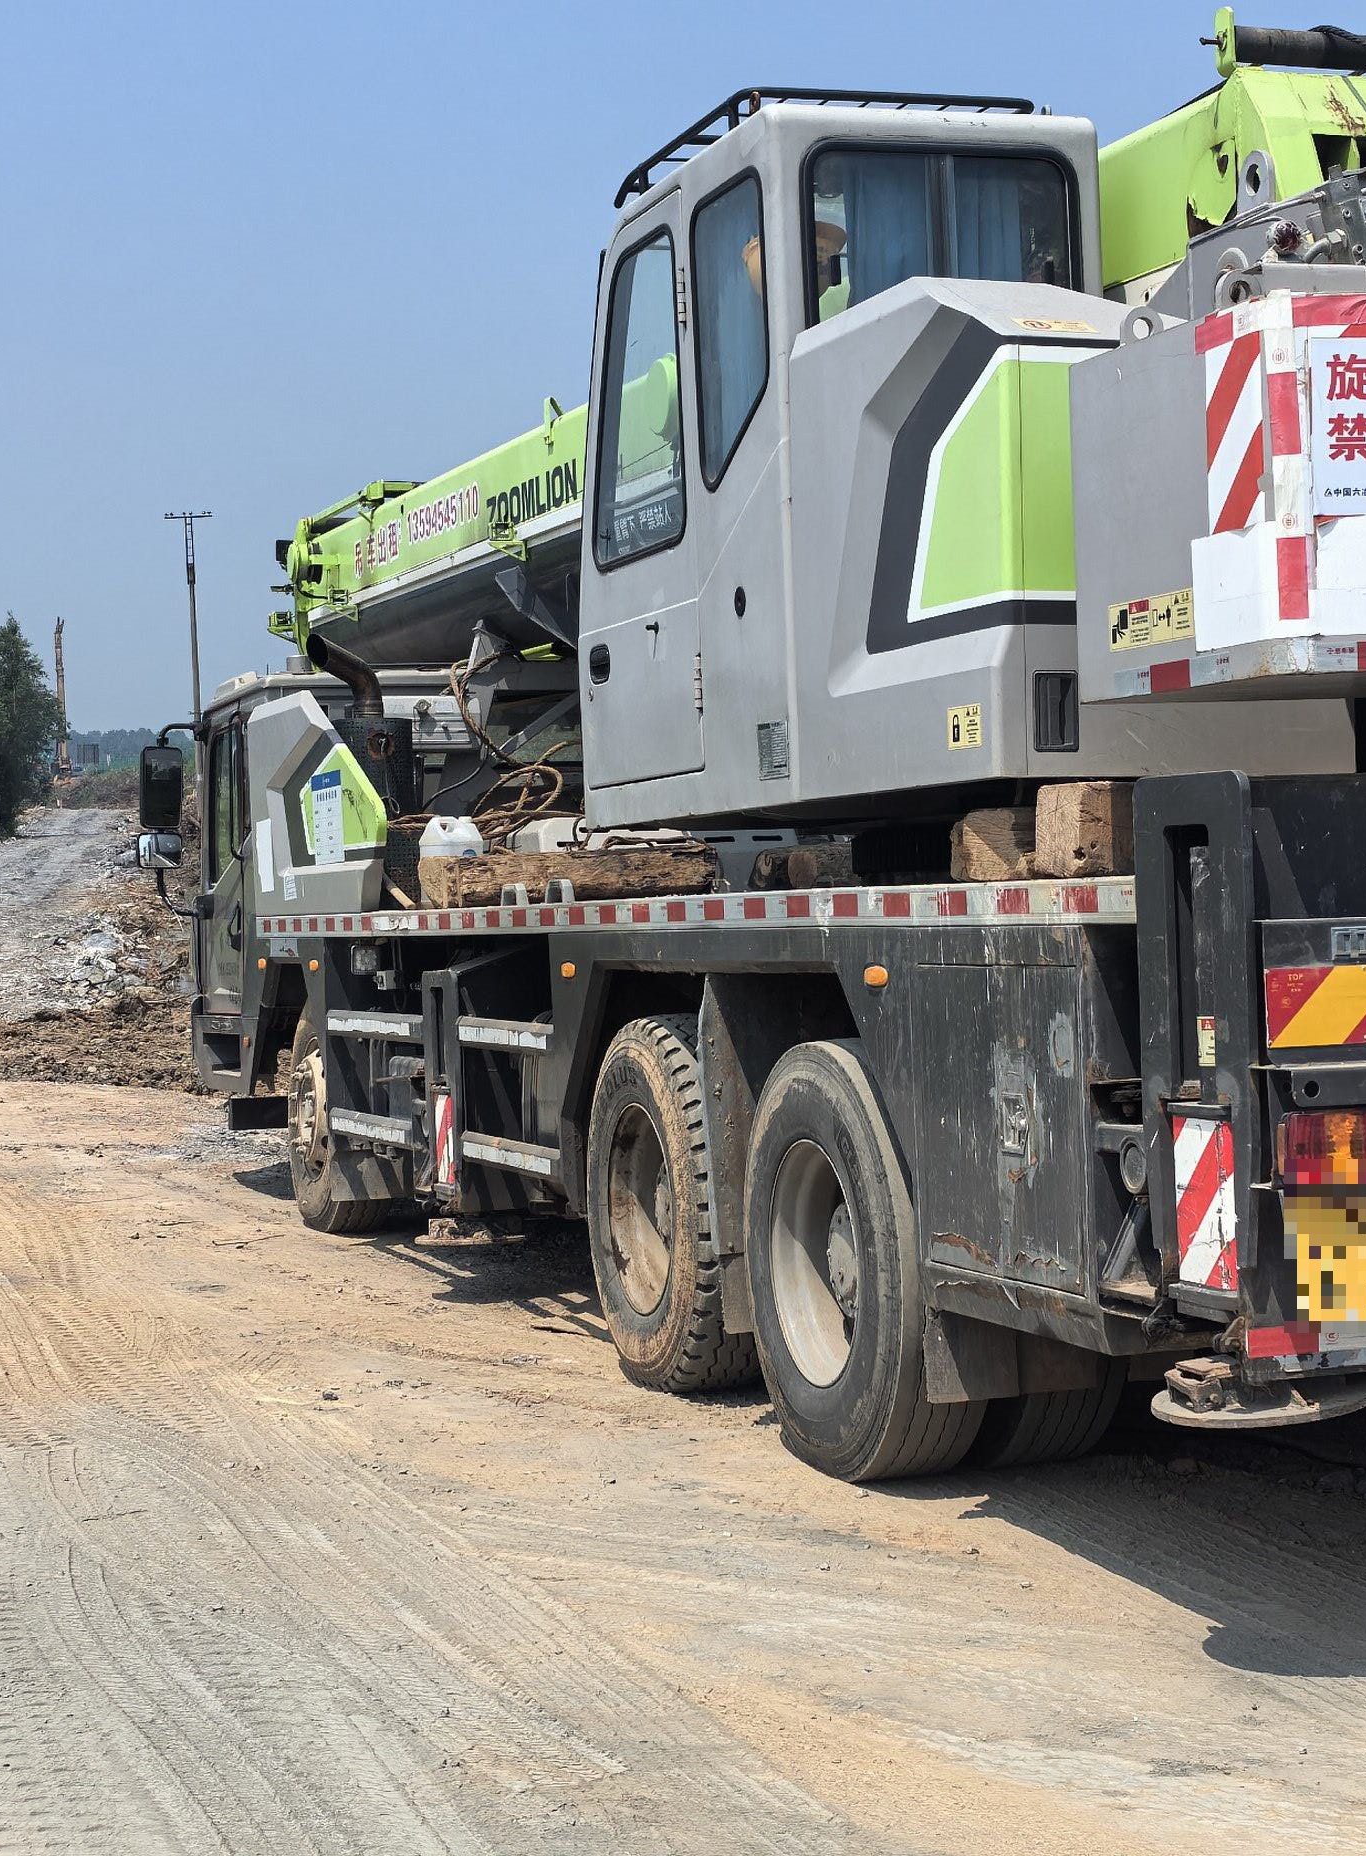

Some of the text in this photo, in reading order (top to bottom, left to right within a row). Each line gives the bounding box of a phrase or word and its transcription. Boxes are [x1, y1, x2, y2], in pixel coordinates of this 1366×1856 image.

[487, 458, 578, 525] ZOOMLION
[354, 520, 399, 578] 吊车出租
